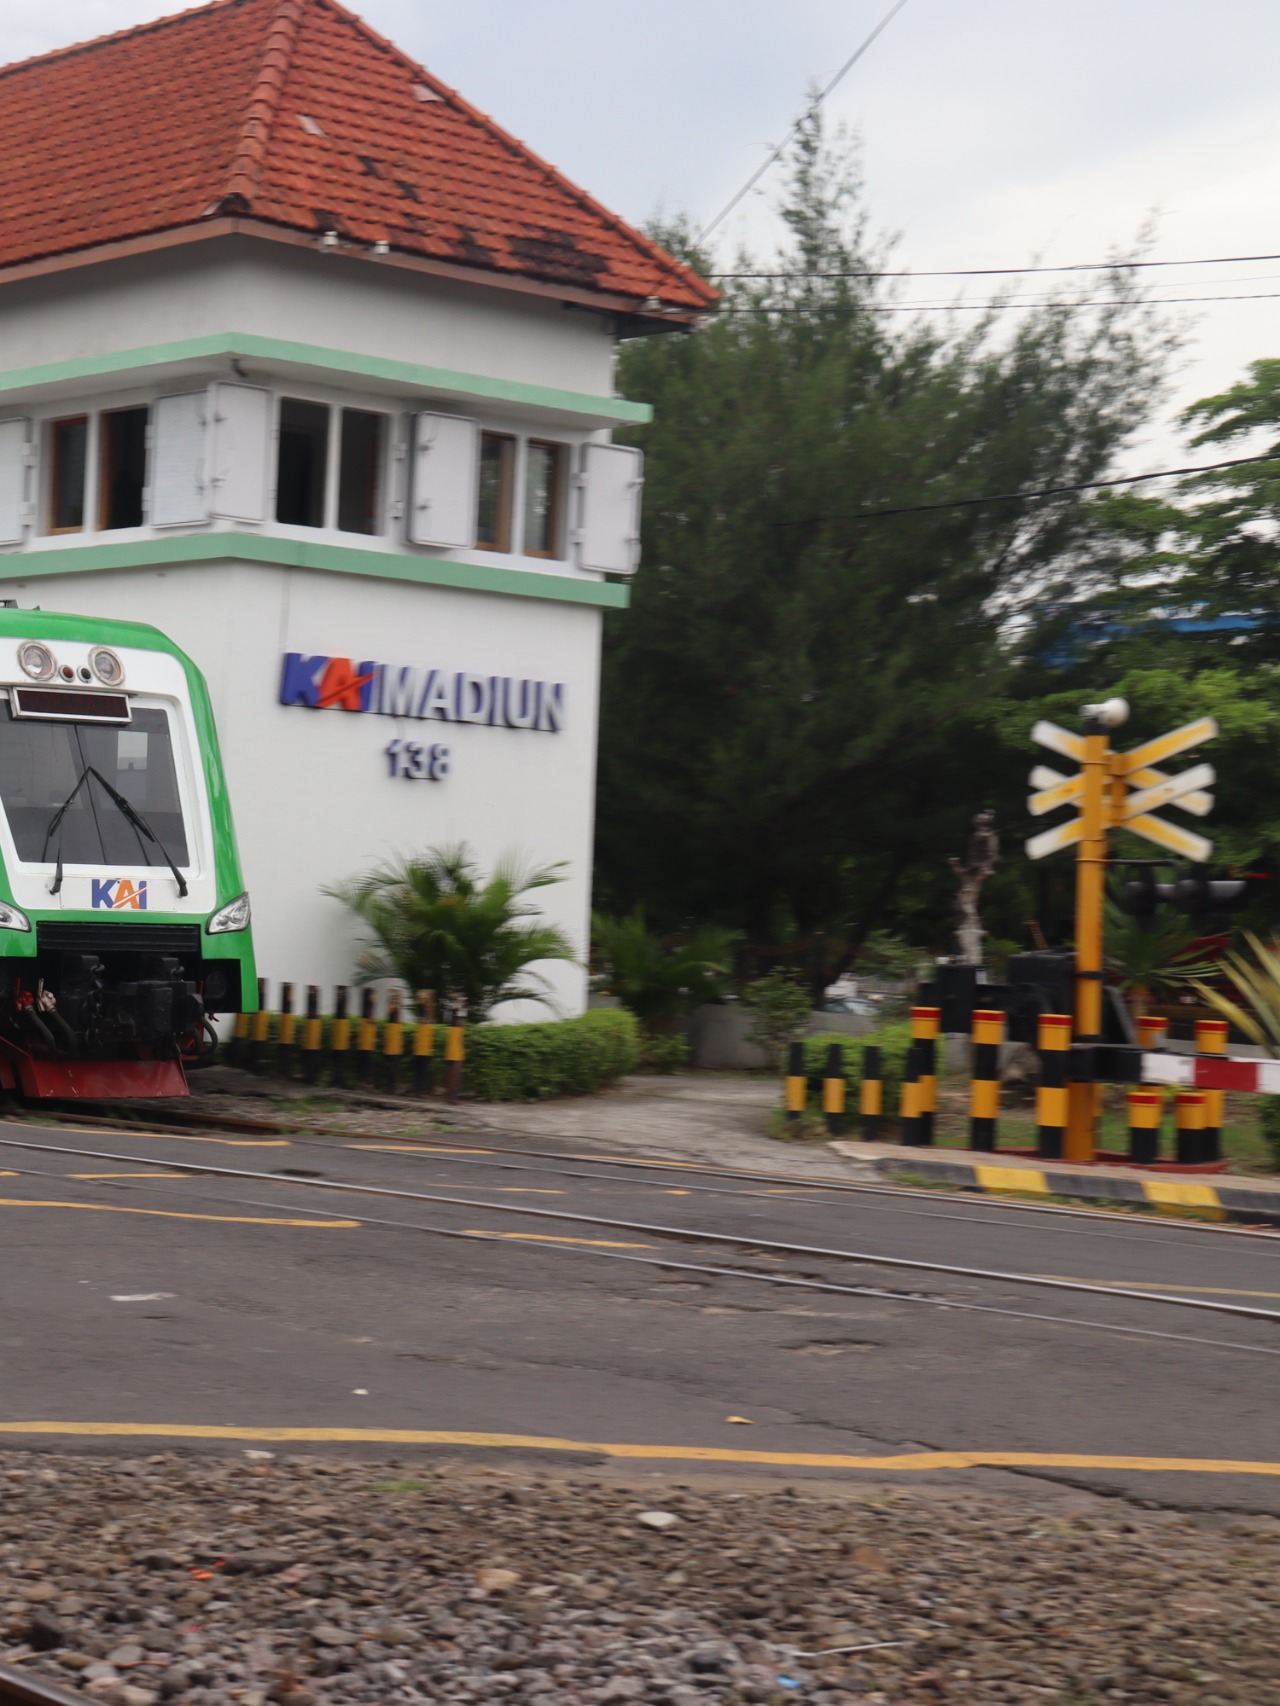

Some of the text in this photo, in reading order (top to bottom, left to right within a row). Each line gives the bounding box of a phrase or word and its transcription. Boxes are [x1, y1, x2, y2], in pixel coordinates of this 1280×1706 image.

[280, 652, 565, 732] KAI MADIUN
[91, 878, 148, 910] KAI
